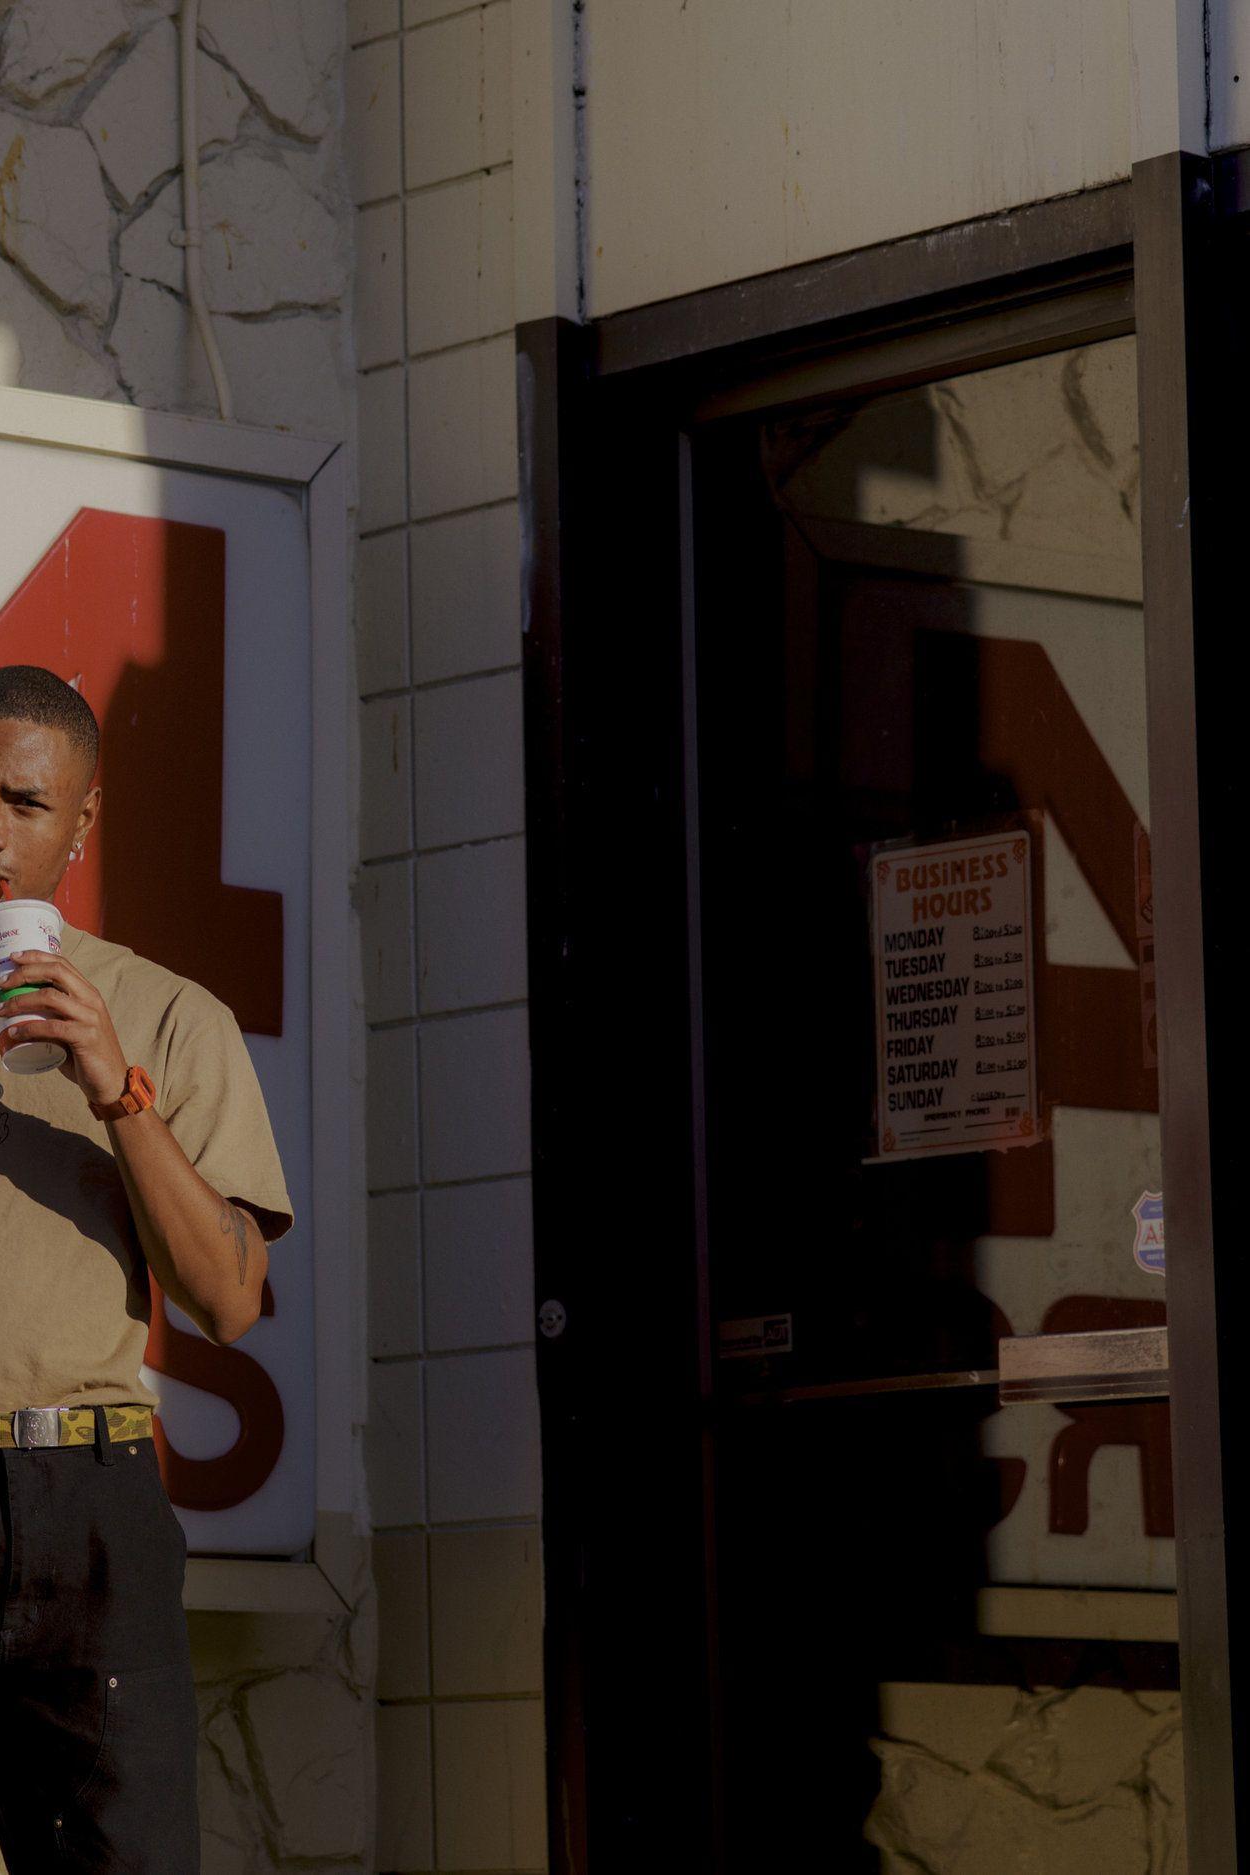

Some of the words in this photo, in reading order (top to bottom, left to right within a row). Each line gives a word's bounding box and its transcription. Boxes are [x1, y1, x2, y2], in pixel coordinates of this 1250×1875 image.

[913, 886, 992, 924] HOURS
[885, 926, 944, 952] MONDAY
[886, 953, 945, 979] TUESDAY
[886, 977, 969, 1005] WEDNESDAY
[886, 1005, 958, 1031] THURSDAY
[887, 1035, 934, 1058] FRIDAY
[887, 1058, 957, 1085] SATURDAY
[888, 1087, 943, 1111] SUNDAY
